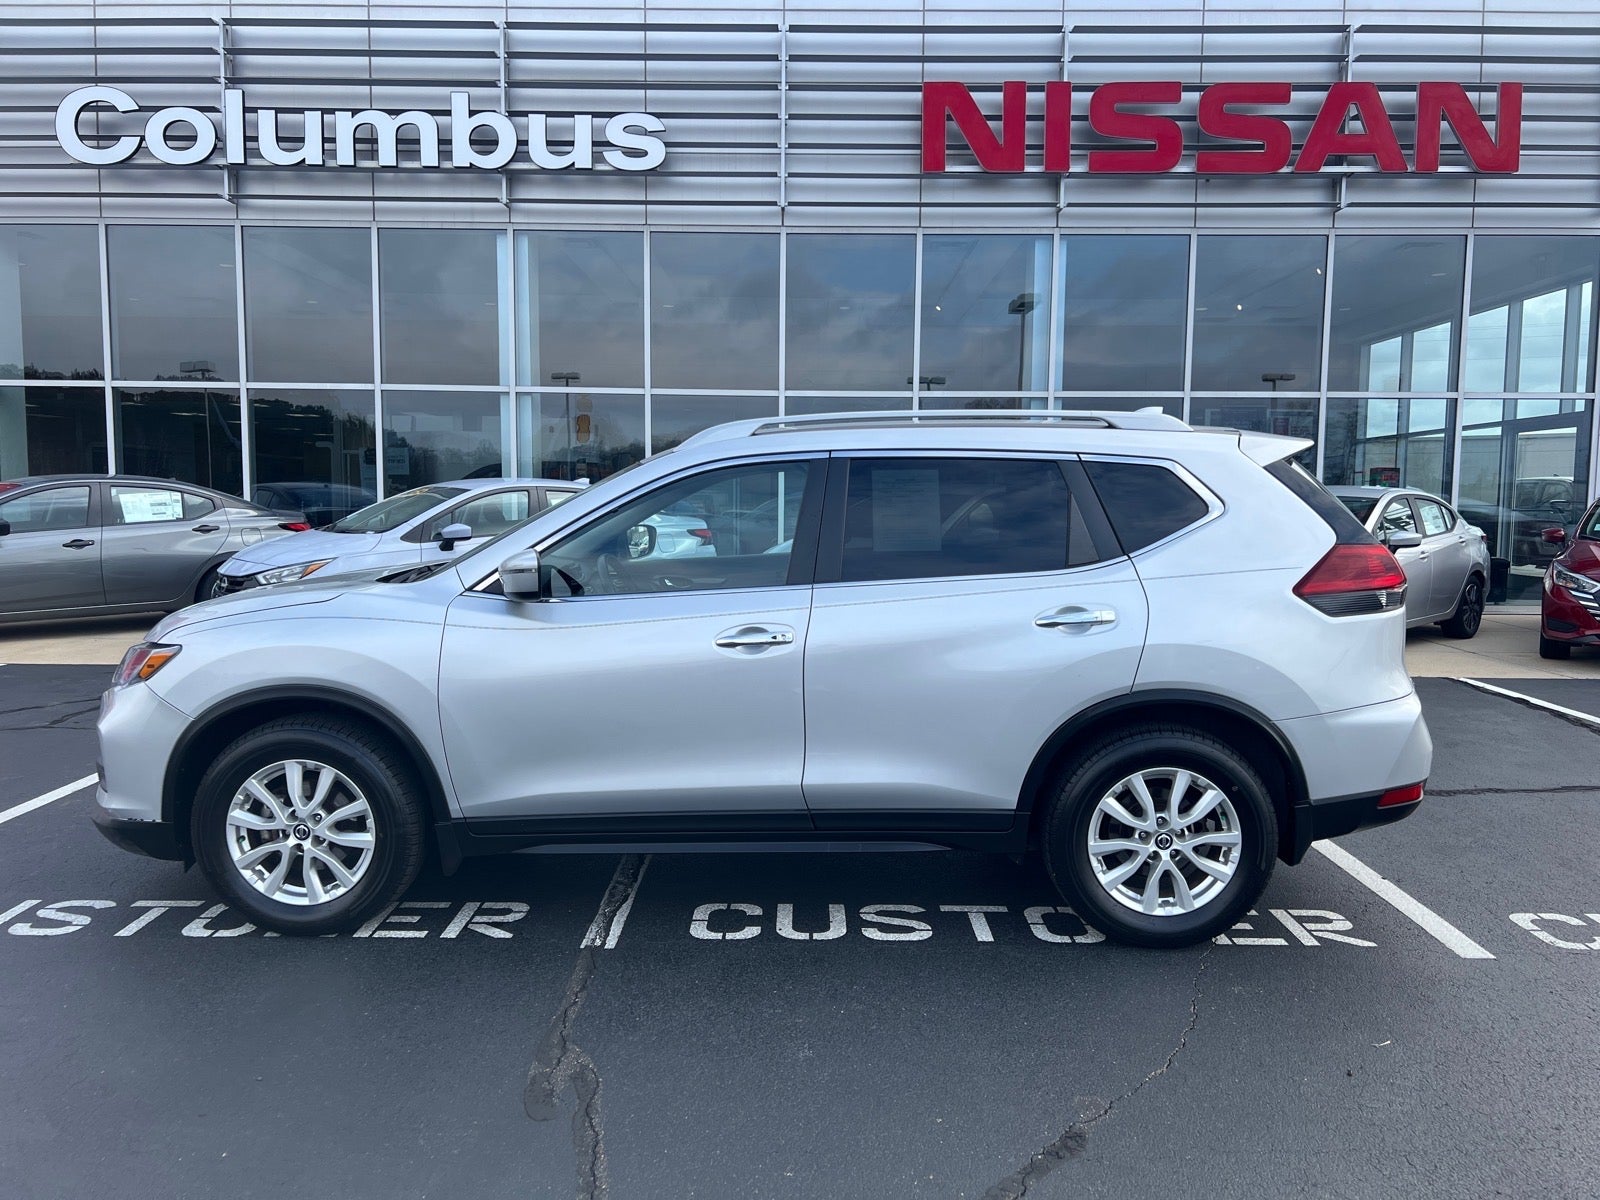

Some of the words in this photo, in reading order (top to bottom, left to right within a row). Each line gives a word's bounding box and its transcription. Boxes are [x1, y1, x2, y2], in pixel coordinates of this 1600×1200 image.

[55, 85, 666, 171] Columbus
[921, 80, 1524, 174] NISSAN
[0, 899, 530, 938] STOER
[690, 903, 1378, 946] CUSTOER
